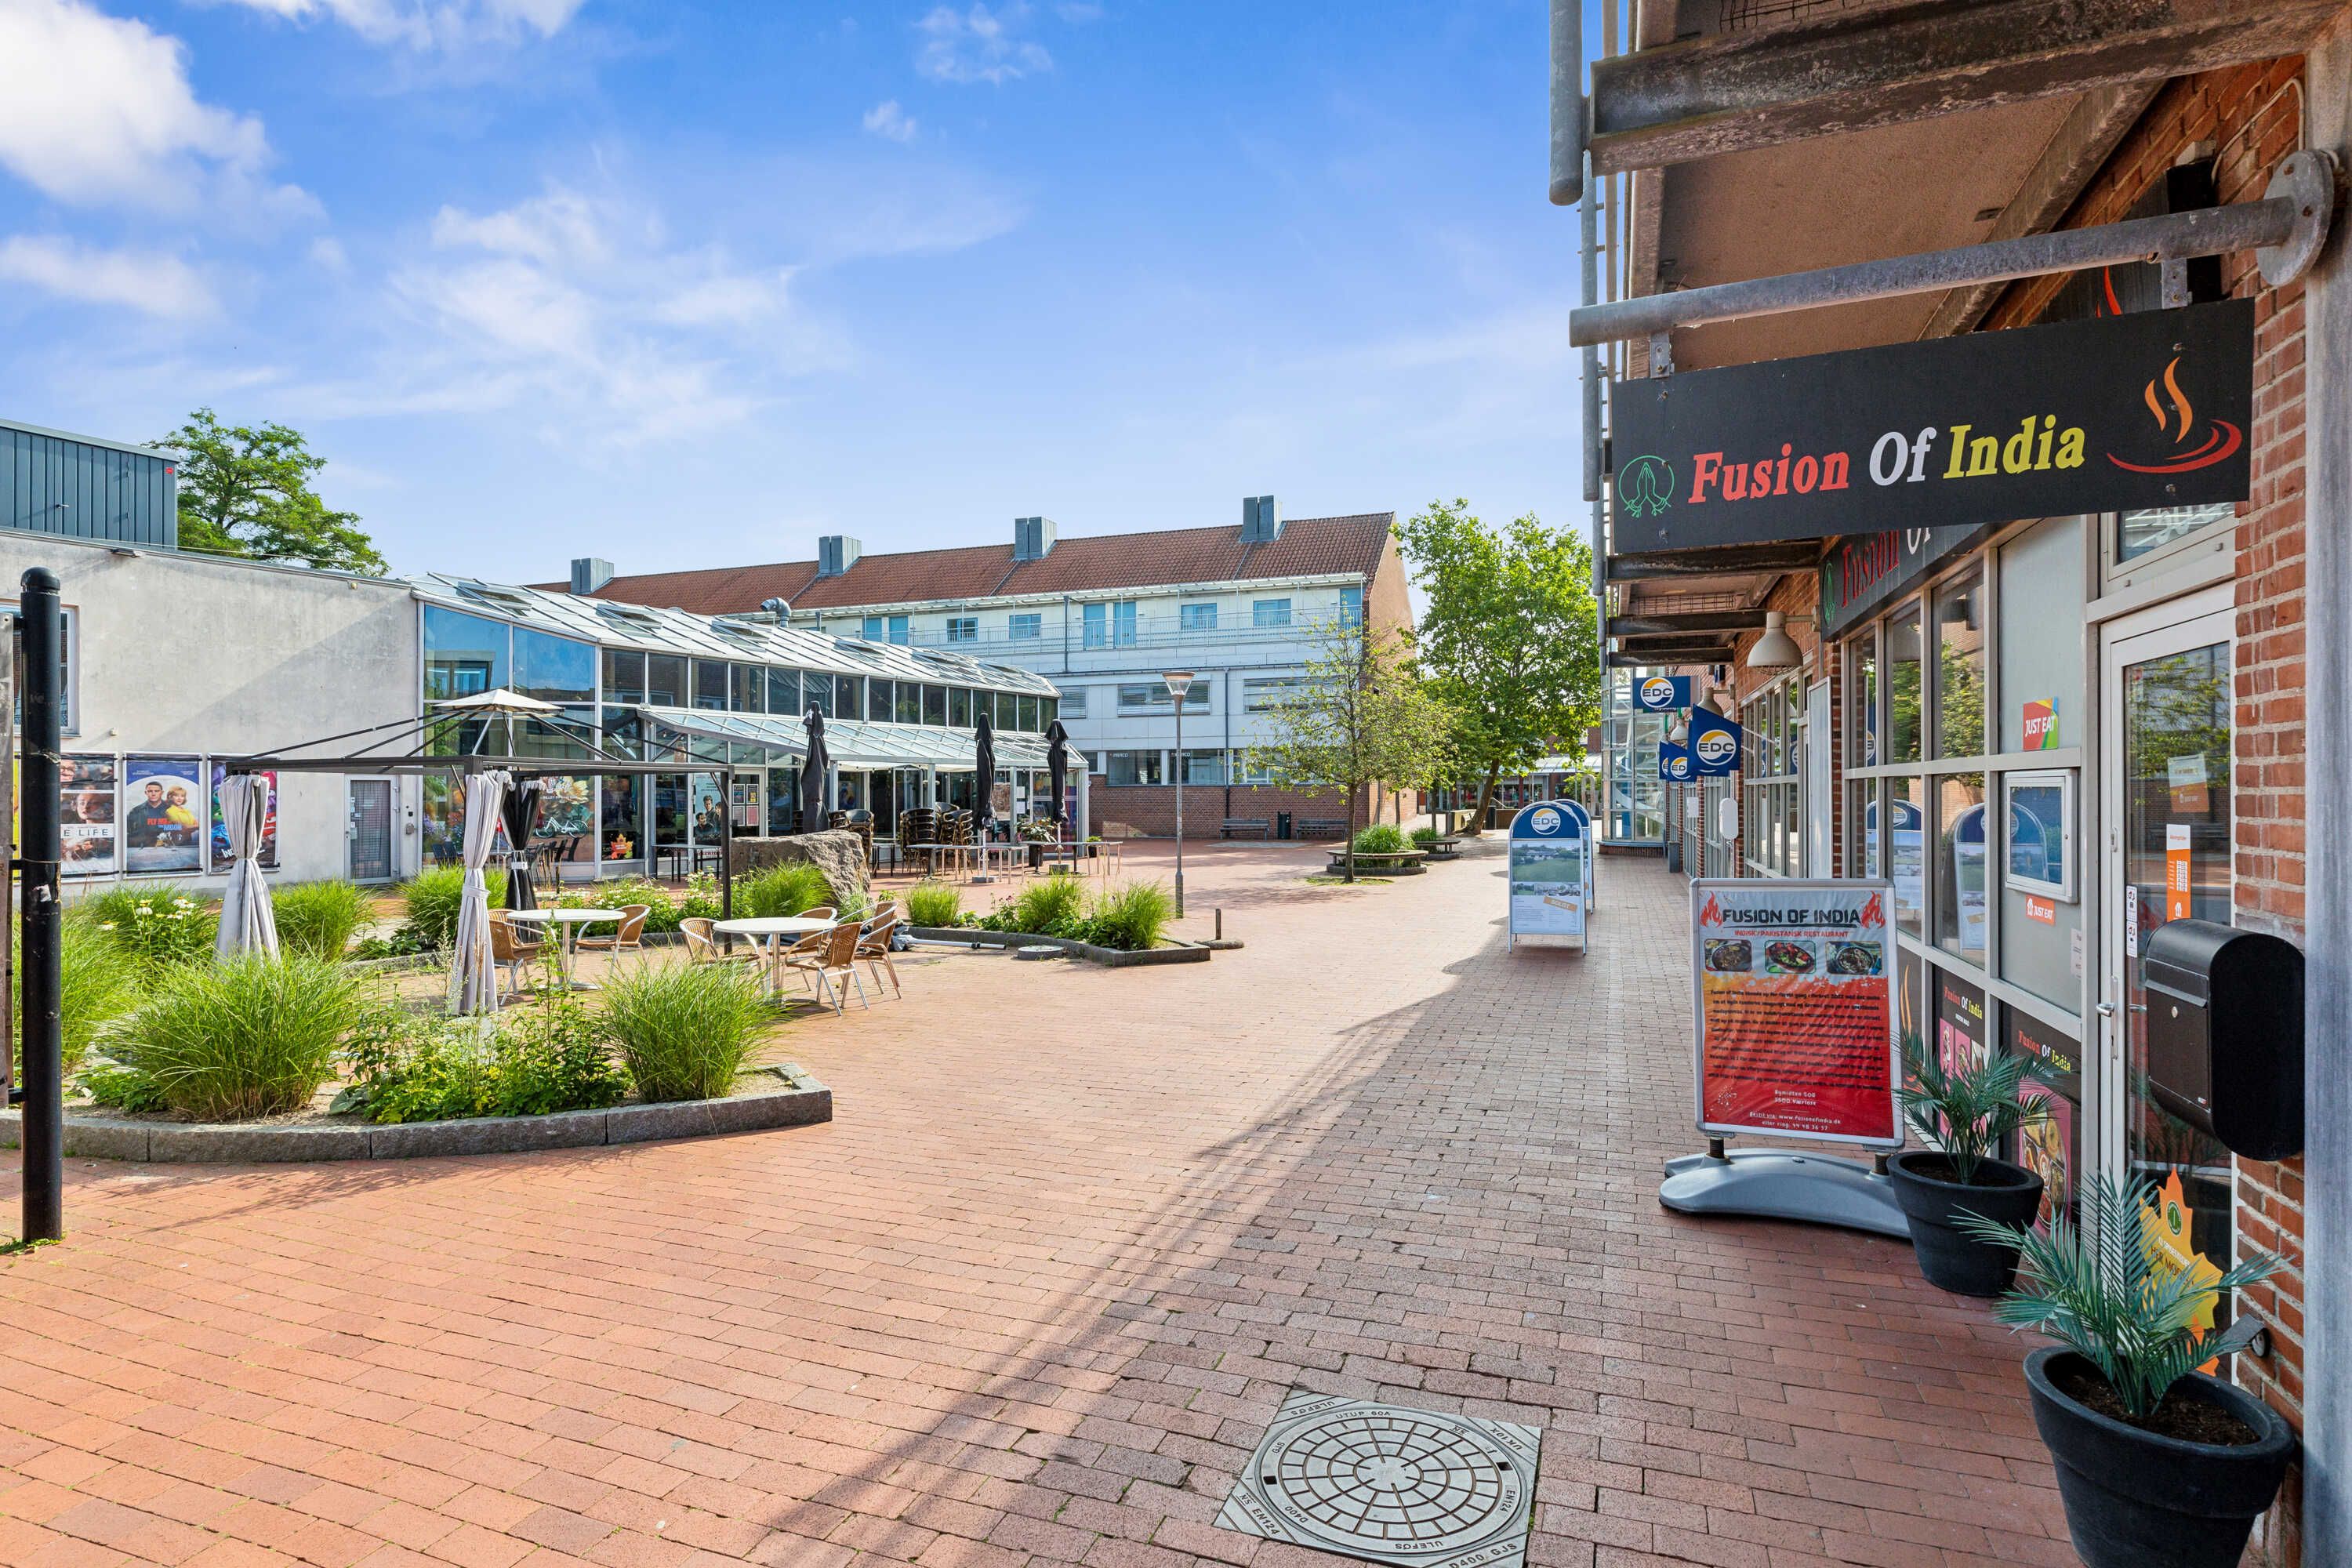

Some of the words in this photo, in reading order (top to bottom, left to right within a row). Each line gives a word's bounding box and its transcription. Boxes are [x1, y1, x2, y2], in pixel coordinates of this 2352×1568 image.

[1687, 442, 1849, 504] Fusion
[1869, 427, 1937, 486] Of
[1943, 414, 2085, 480] India
[1842, 528, 1900, 608] Fusion
[1642, 688, 1672, 698] EDC
[2025, 718, 2042, 738] JUST
[2042, 716, 2056, 733] EAT
[1698, 742, 1735, 753] EDC
[78, 828, 109, 837] LIFE
[1722, 909, 1782, 924] FUSION
[1788, 909, 1809, 924] OF
[1813, 909, 1860, 924] INDIA
[2034, 906, 2044, 916] JUST
[2044, 909, 2053, 920] EAT
[1944, 985, 1960, 1006] Fusion
[1961, 996, 1968, 1011] Of
[1969, 999, 1983, 1019] India
[2019, 1029, 2040, 1054] Fusion
[2042, 1044, 2051, 1058] Of
[1251, 1507, 1280, 1535] EN124
[1284, 1505, 1309, 1523] D400
[1448, 1553, 1485, 1568] D400
[1490, 1542, 1518, 1556] GJS
